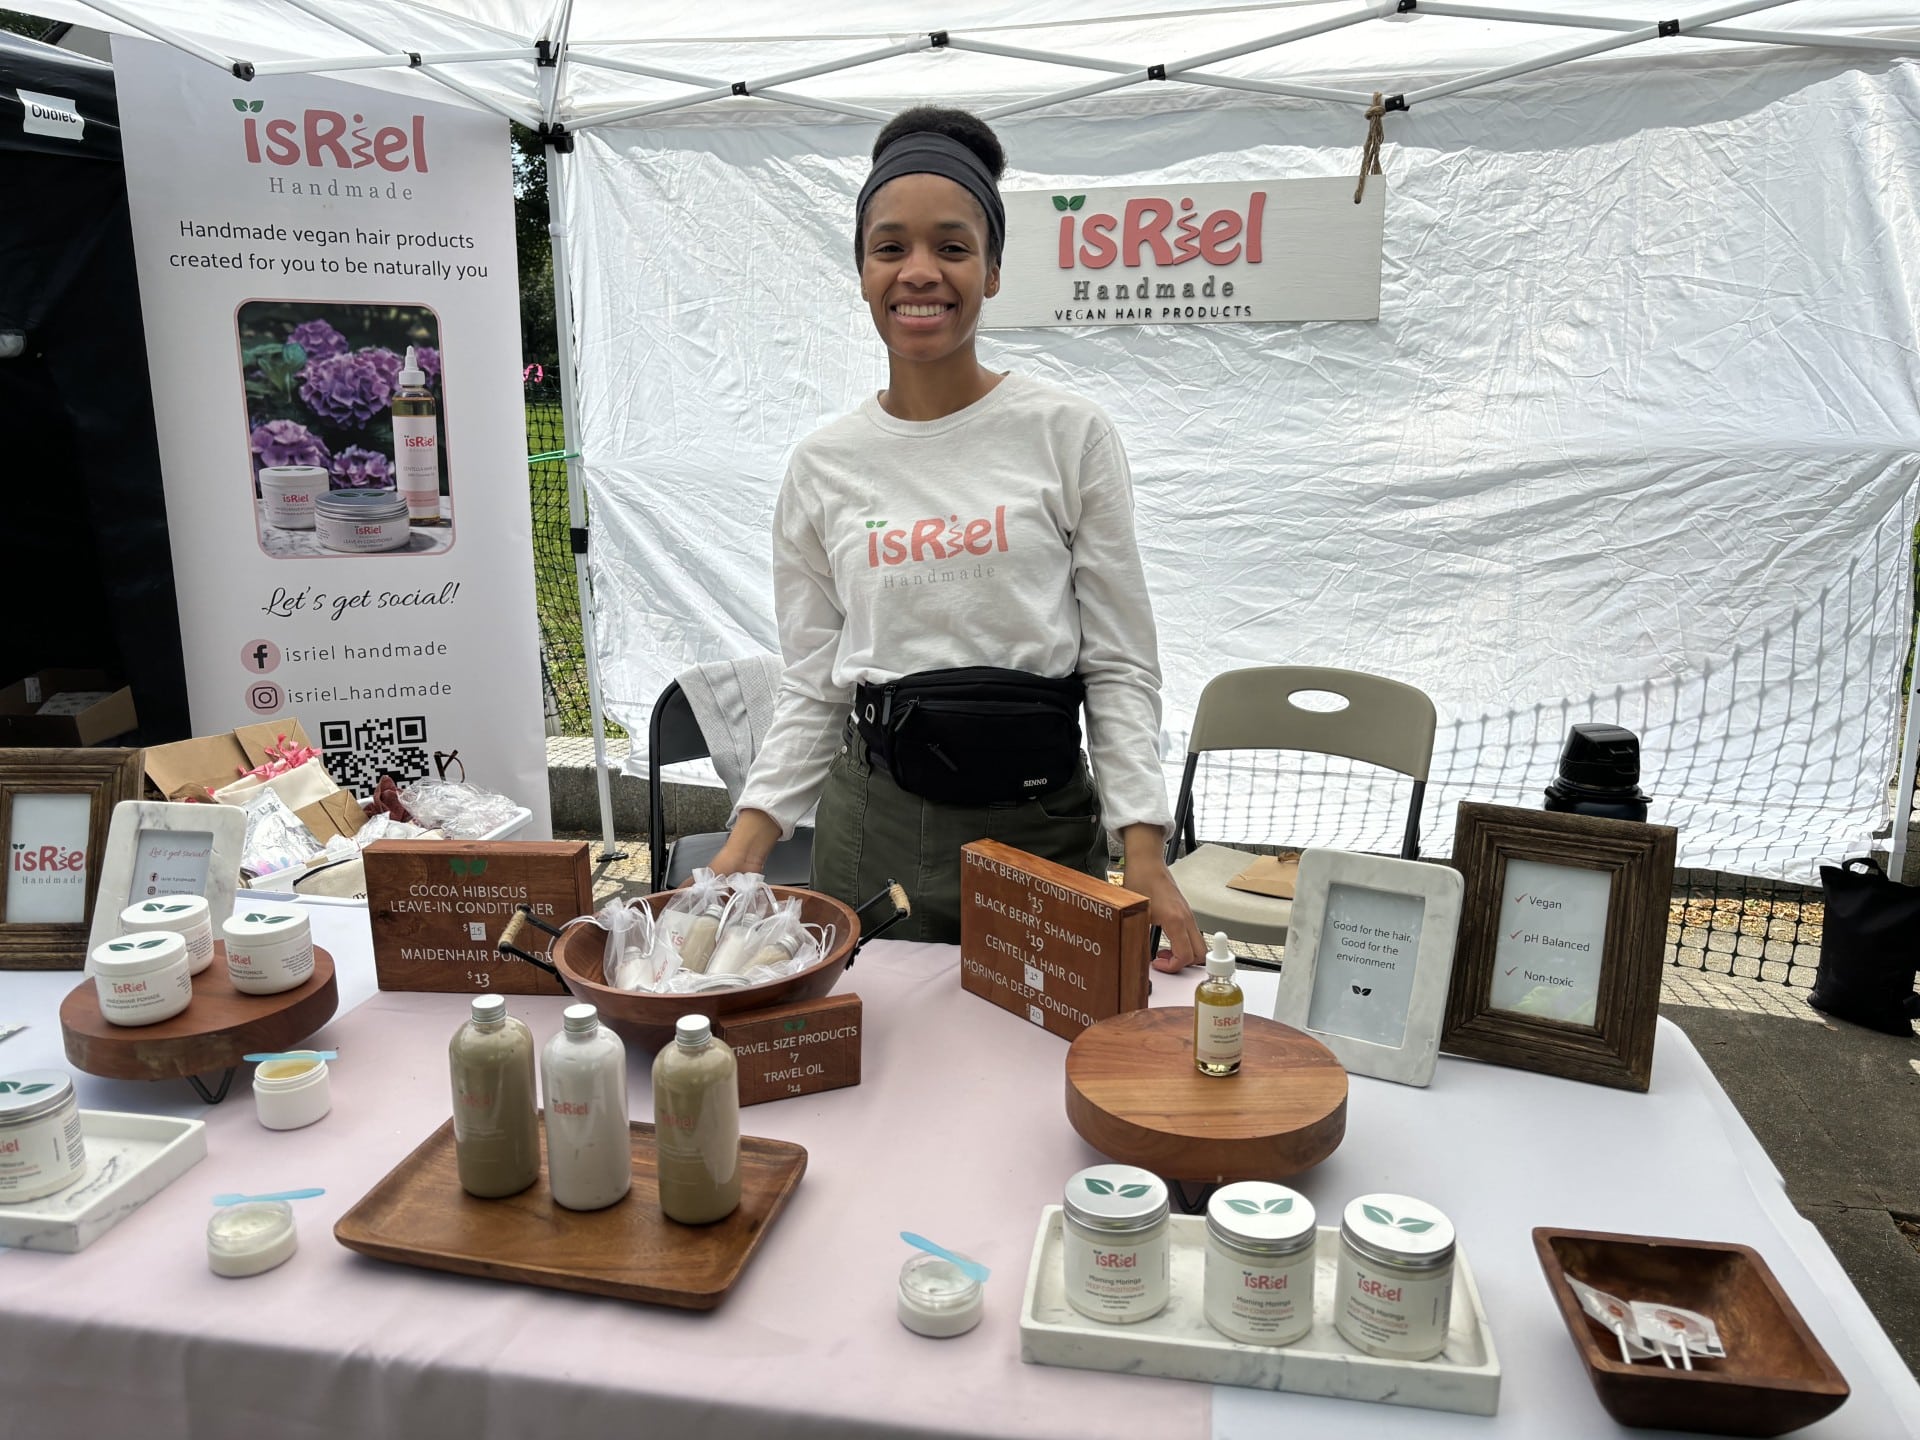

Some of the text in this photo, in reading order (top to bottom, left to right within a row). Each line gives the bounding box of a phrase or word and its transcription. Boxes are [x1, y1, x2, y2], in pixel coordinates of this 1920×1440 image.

[269, 177, 413, 200] Handmade
[180, 220, 474, 250] Handmade vegan hair products
[169, 252, 488, 281] created for you to be naturally you
[1073, 275, 1234, 300] Handmade
[1055, 305, 1252, 321] VEGAN HAIR PRODUCTS
[884, 563, 995, 589] Handmade
[262, 582, 460, 621] Let's get social!
[286, 641, 448, 662] isriel handmade
[288, 681, 452, 703] isriel_handmade
[22, 874, 83, 885] Handmade
[966, 852, 1113, 921] BLACK BERRY CONDITIONER
[409, 884, 527, 899] COCOA HIBISCUS
[390, 900, 452, 913] LEAVE-IN
[1027, 892, 1044, 913] $15
[1529, 895, 1562, 910] Vegan
[975, 892, 1101, 957] BLACK BERRY SHAMPOO
[1333, 920, 1358, 933] Good
[1359, 923, 1373, 935] for
[1374, 927, 1390, 939] the
[1025, 931, 1044, 951] $19
[1341, 937, 1399, 956] Good for the
[1524, 933, 1591, 952] pH Balanced
[401, 948, 554, 963] MAIDENHAIR PODE
[985, 934, 1088, 991] CENTELLA HAIR OIL
[1336, 952, 1396, 970] environment
[467, 971, 490, 987] $13
[963, 957, 1008, 988] MORINGA
[1010, 979, 1036, 1000] DEEP
[1524, 970, 1575, 988] Non-toxic
[773, 1036, 797, 1051] SIZE
[799, 1026, 857, 1046] PRODUCTS
[790, 1052, 800, 1063] $7
[763, 1063, 825, 1083] TRAVEL OIL
